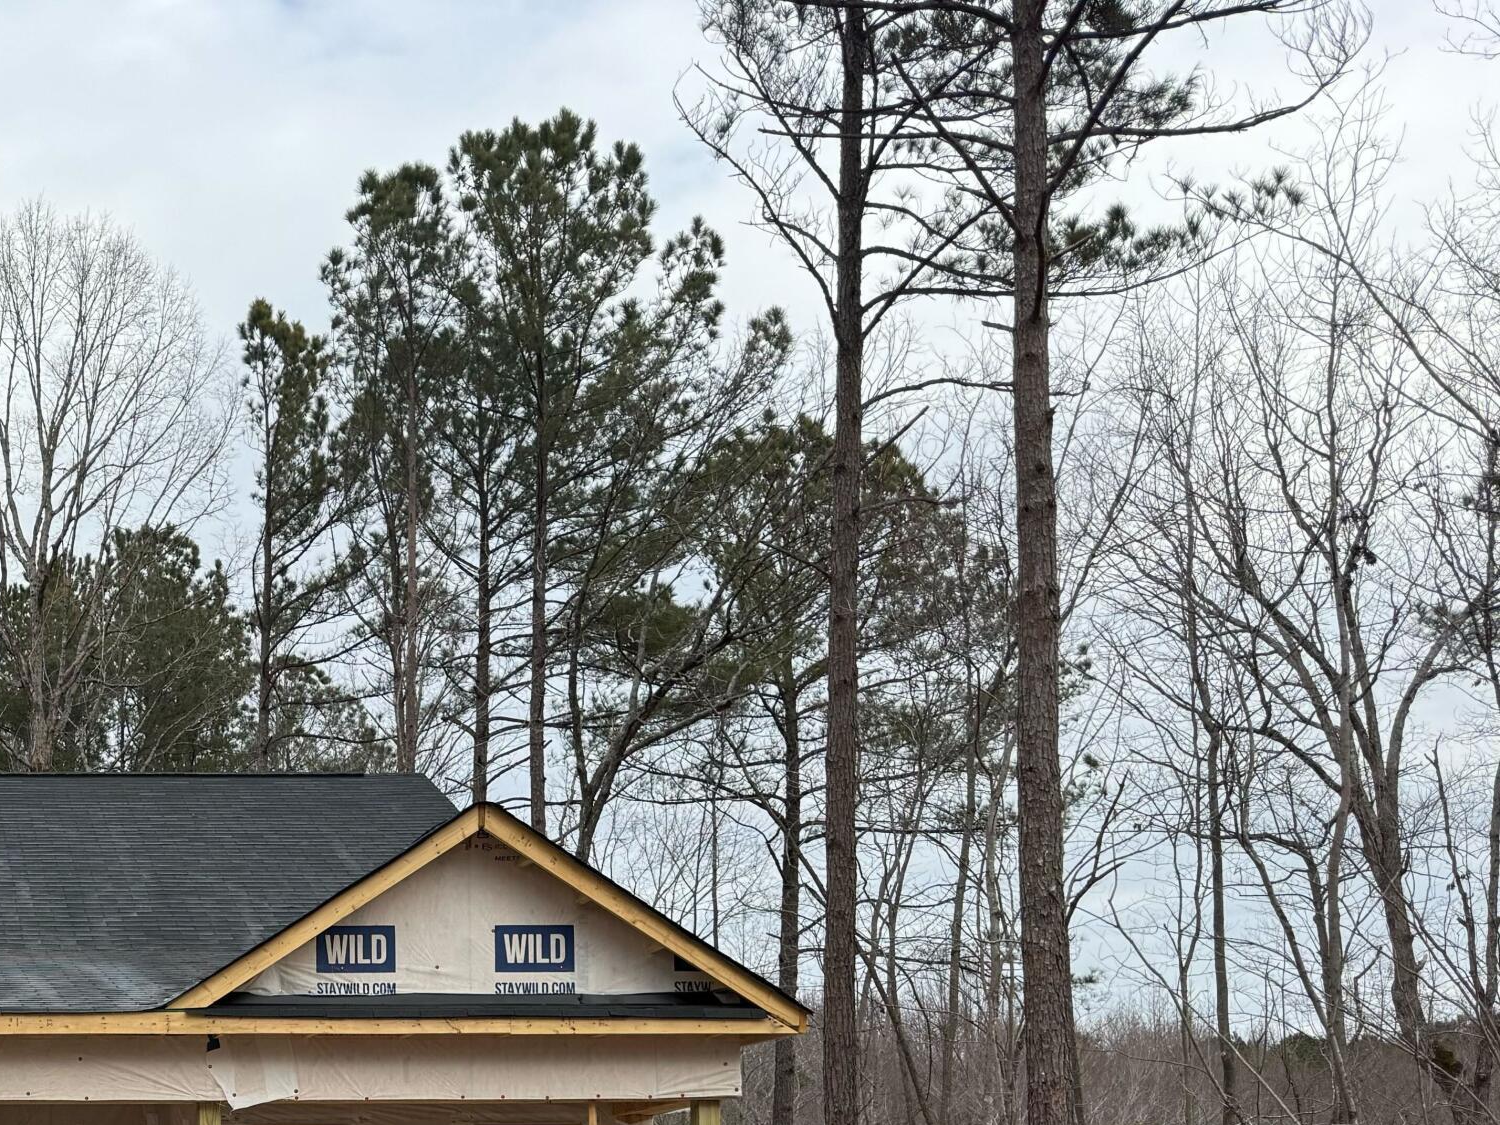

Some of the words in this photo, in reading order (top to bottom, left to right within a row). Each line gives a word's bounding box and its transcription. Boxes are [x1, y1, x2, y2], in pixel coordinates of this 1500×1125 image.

[325, 934, 388, 965] WILD
[503, 933, 566, 964] WILD
[316, 982, 397, 995] STAYWILD.COM
[494, 982, 576, 994] STAYWILD.COM
